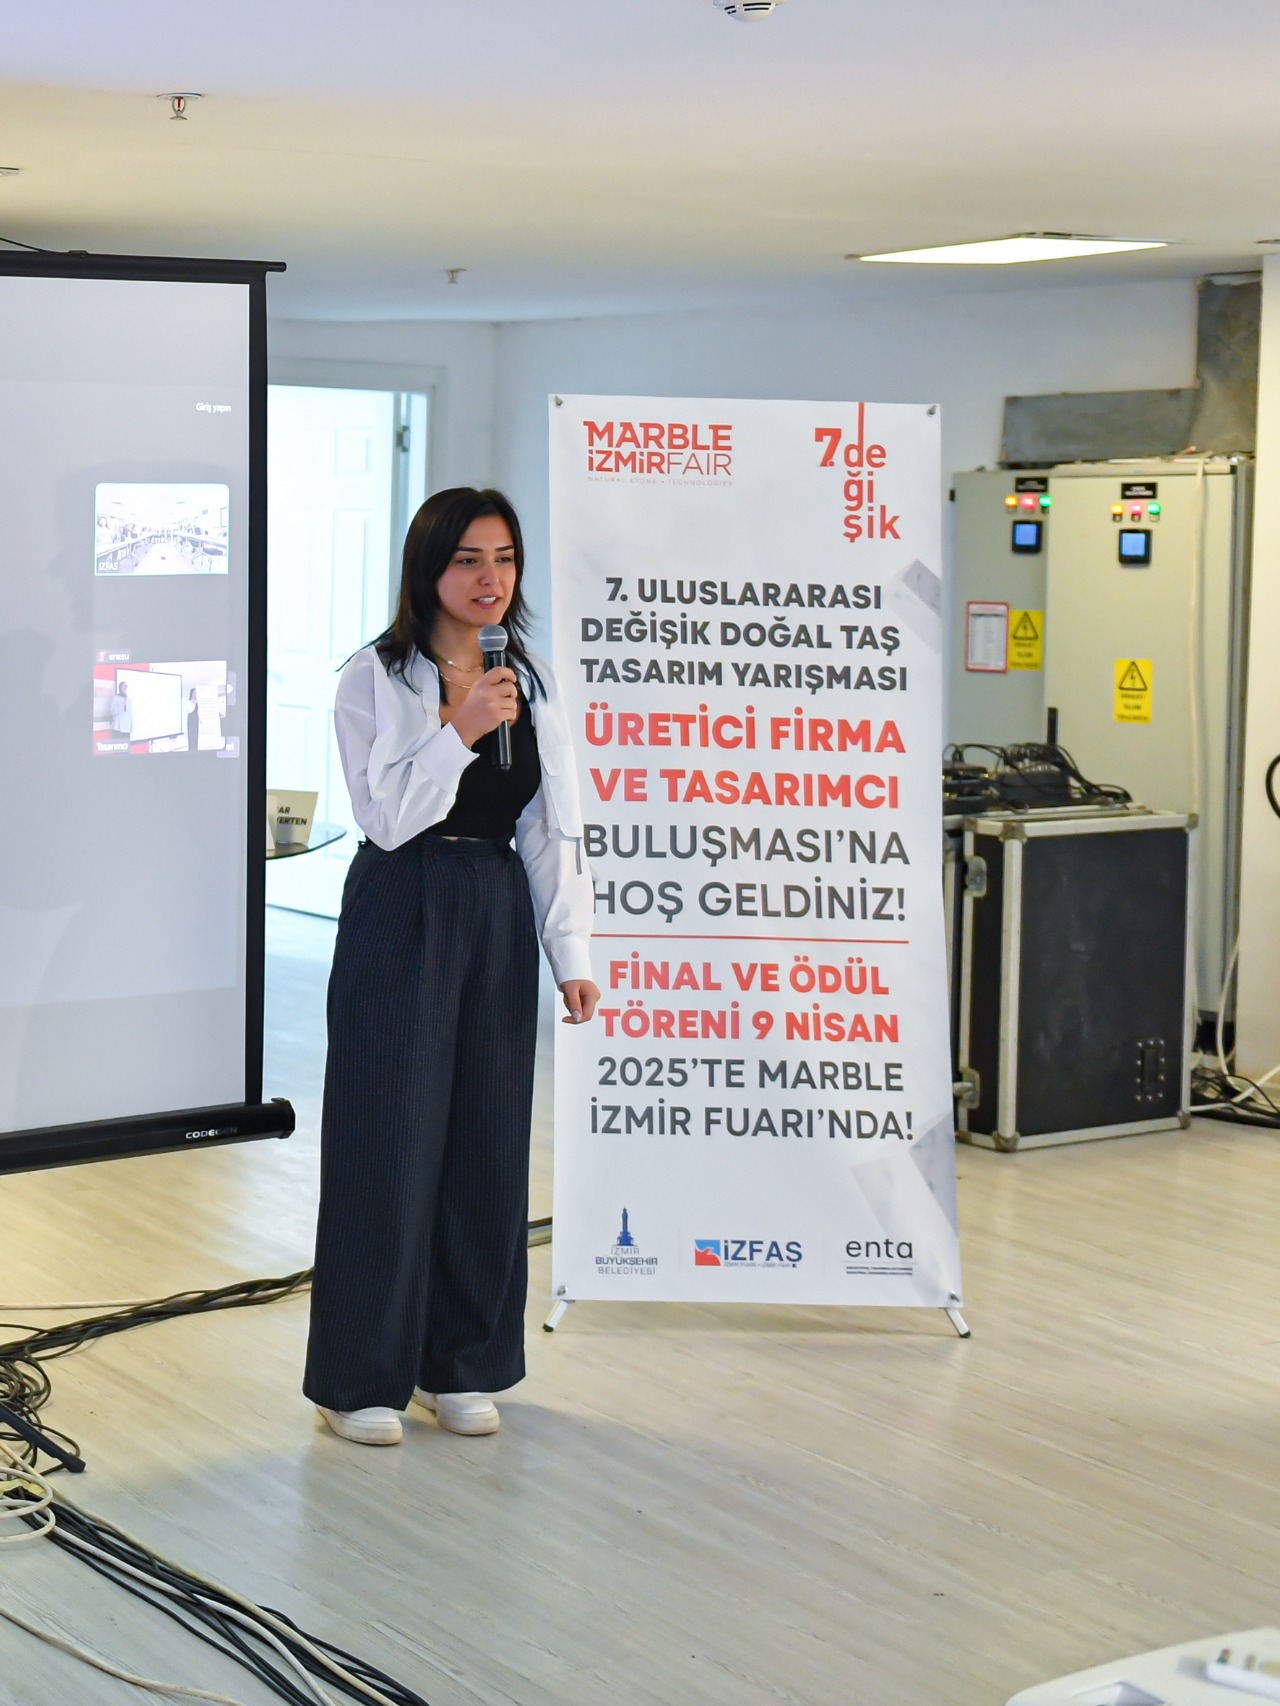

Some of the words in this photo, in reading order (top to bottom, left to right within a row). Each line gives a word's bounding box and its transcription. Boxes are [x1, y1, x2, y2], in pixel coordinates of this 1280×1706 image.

[583, 420, 733, 451] MARBLE
[587, 475, 625, 485] NATURAL
[629, 477, 657, 486] STONE
[667, 478, 734, 488] TECHNOLOGIES
[606, 577, 628, 603] 7.
[637, 578, 882, 611] ULUSLARARASI
[580, 610, 711, 650] DEĞİŞİK
[719, 616, 832, 650] DOĞAL
[840, 625, 900, 656] TAŞ
[580, 658, 723, 686] TASARIM
[732, 662, 907, 694] YARIŞMASI
[584, 702, 756, 750] ÜRETİCİ
[770, 706, 907, 754] FİRMA
[589, 768, 648, 802] VE
[660, 769, 899, 809] TASARIMCI
[592, 879, 684, 924] HOŞ
[698, 875, 906, 922] GELDİNİZ!
[609, 951, 722, 991] FİNAL
[731, 962, 780, 993] VE
[789, 955, 889, 996] ÖDÜL
[598, 1000, 740, 1040] TÖRENİ
[751, 1010, 774, 1040] 9
[786, 1003, 899, 1043] NİSAN
[758, 1059, 904, 1092] MARBLE
[590, 1096, 691, 1136] İZMİR
[846, 1238, 913, 1258] enta
